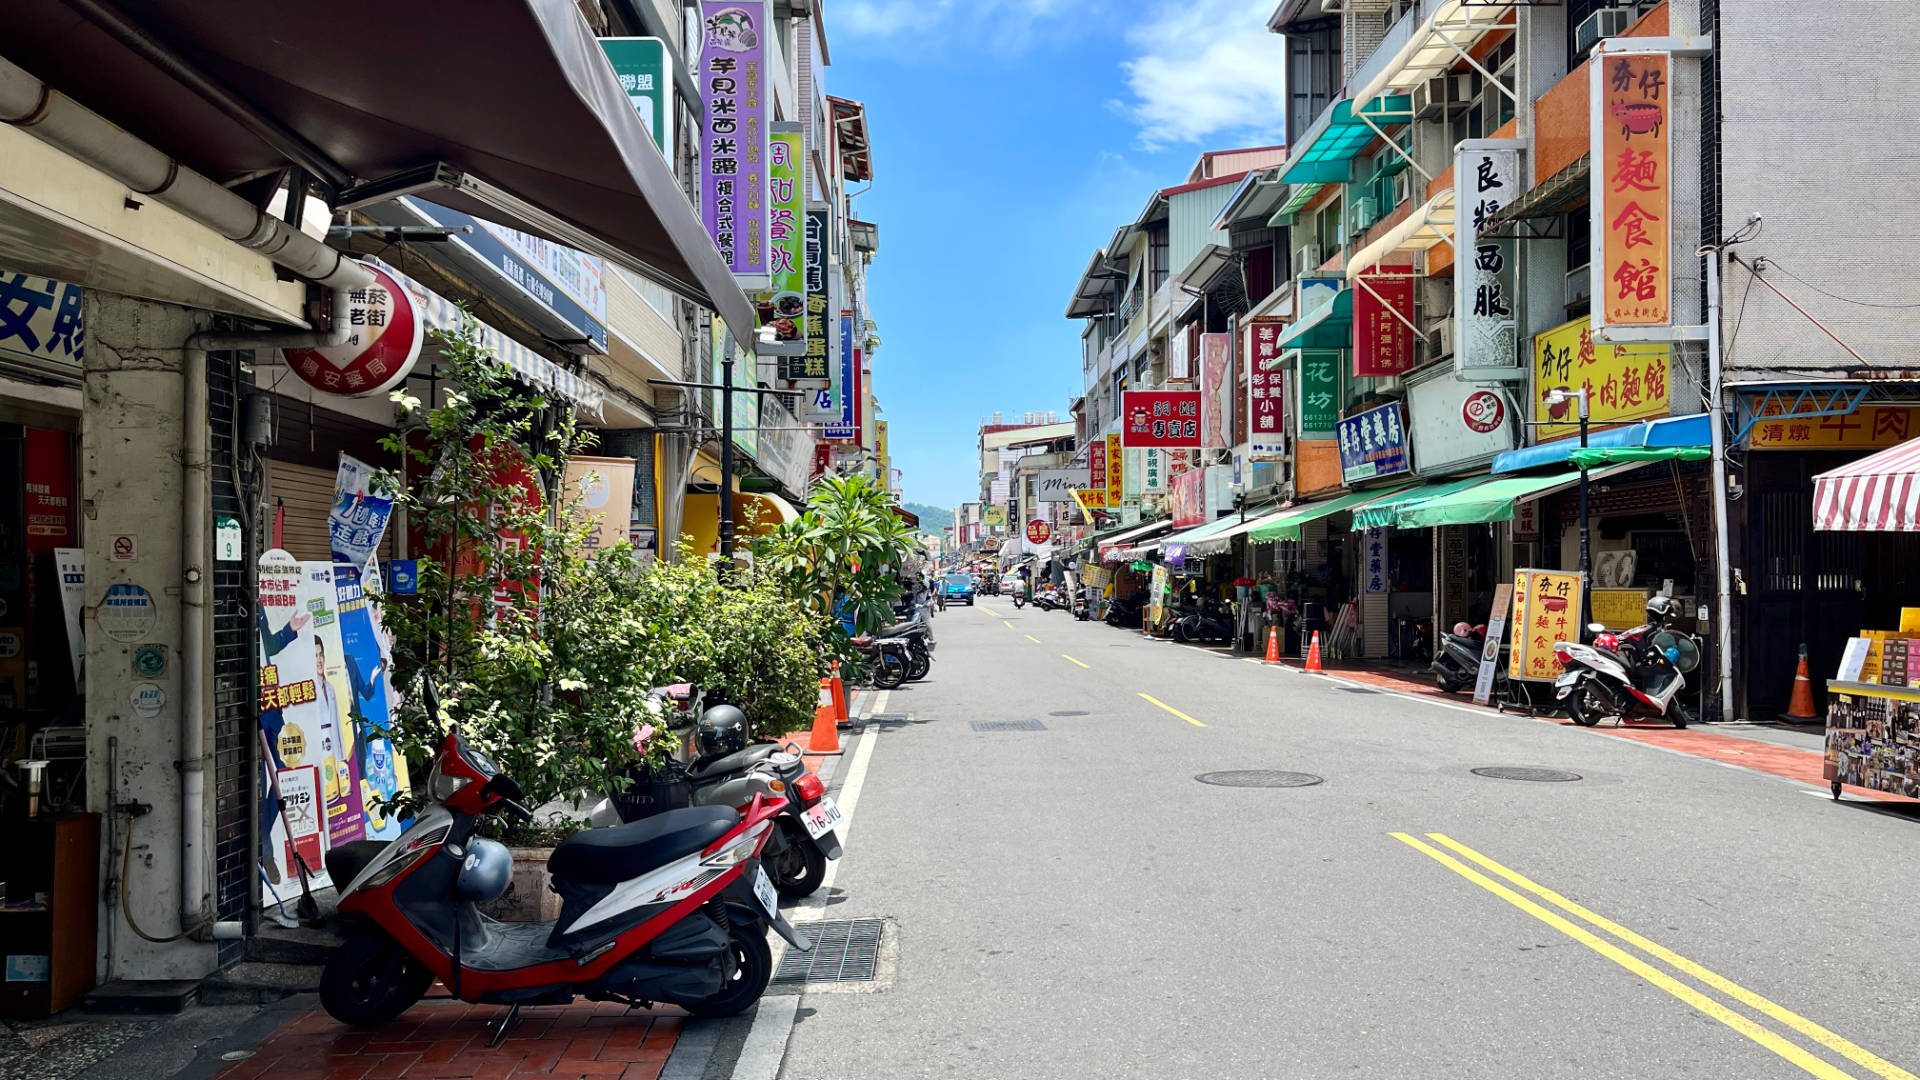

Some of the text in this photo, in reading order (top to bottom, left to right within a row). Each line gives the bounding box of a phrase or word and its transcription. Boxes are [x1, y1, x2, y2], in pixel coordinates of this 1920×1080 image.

[1473, 156, 1511, 319] 良將西服
[1611, 147, 1661, 302] 麵食館
[349, 308, 386, 327] 老街
[1305, 362, 1335, 410] 花坊
[1581, 358, 1665, 417] 牛肉麵館
[1152, 420, 1197, 438] 專賣店
[1761, 424, 1811, 442] 清燉
[1819, 403, 1911, 441] 牛肉
[1042, 477, 1088, 491] Mina
[226, 542, 232, 558] 9
[1532, 615, 1549, 669] 麵食館
